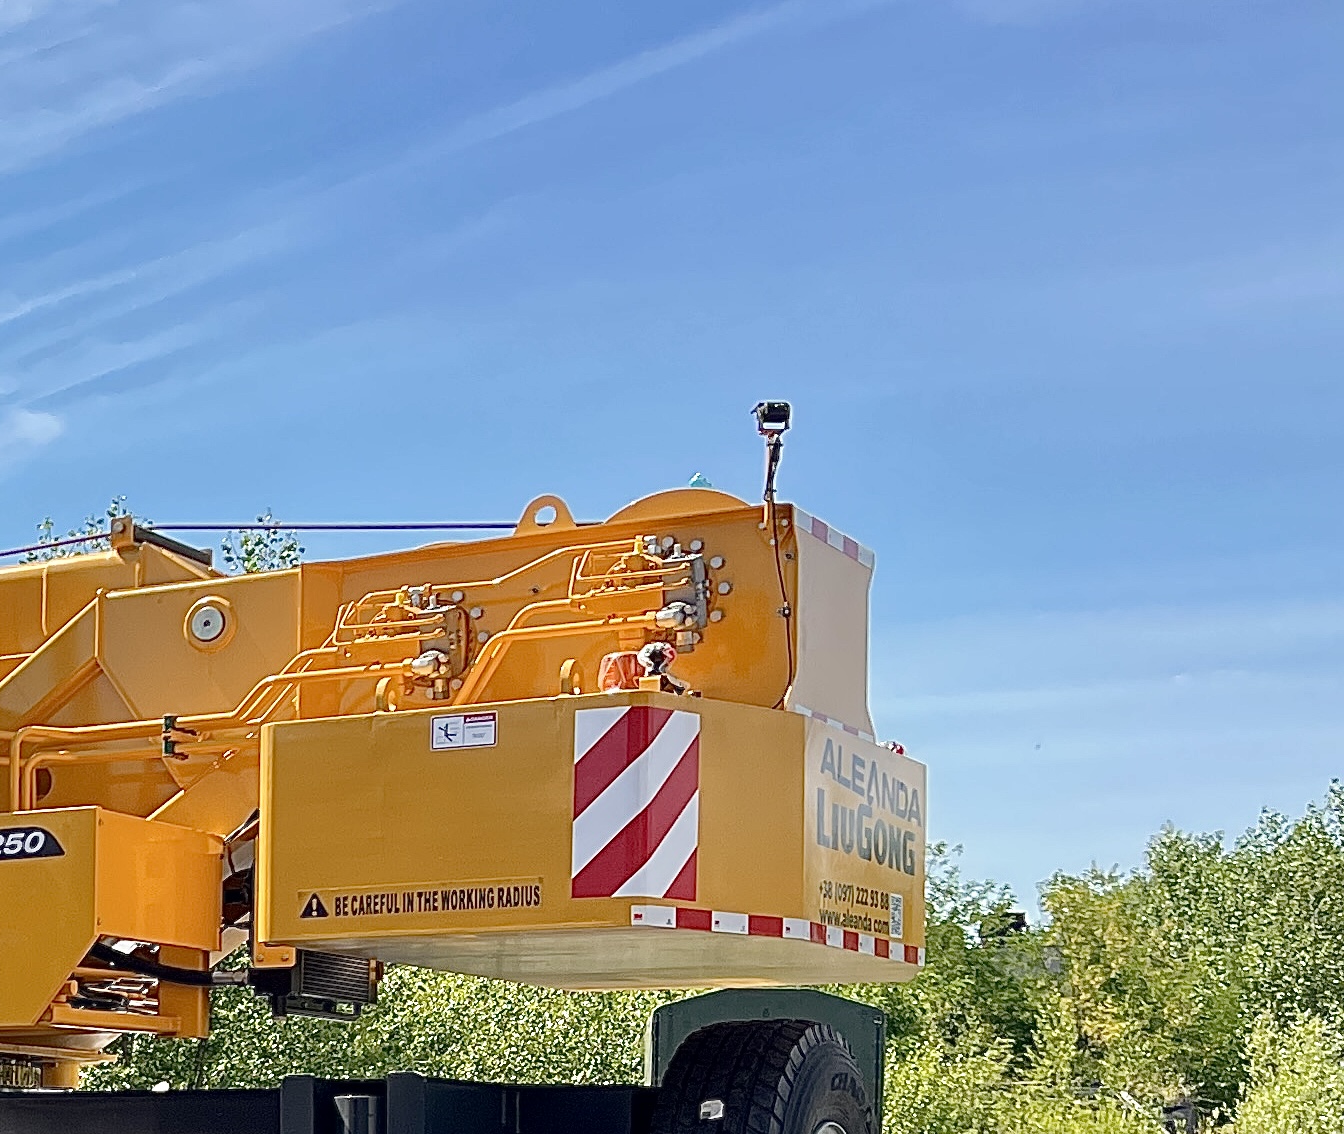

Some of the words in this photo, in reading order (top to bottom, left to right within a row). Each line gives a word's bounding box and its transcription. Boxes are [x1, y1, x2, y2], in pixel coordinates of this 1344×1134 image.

[819, 737, 923, 828] ALEANDA
[334, 895, 349, 917] BE
[350, 893, 401, 916] CAREFUL
[402, 892, 415, 913] IN
[416, 890, 439, 912] THE
[441, 888, 495, 912] WORKING
[497, 885, 541, 909] RADIUS
[855, 886, 869, 906] 222
